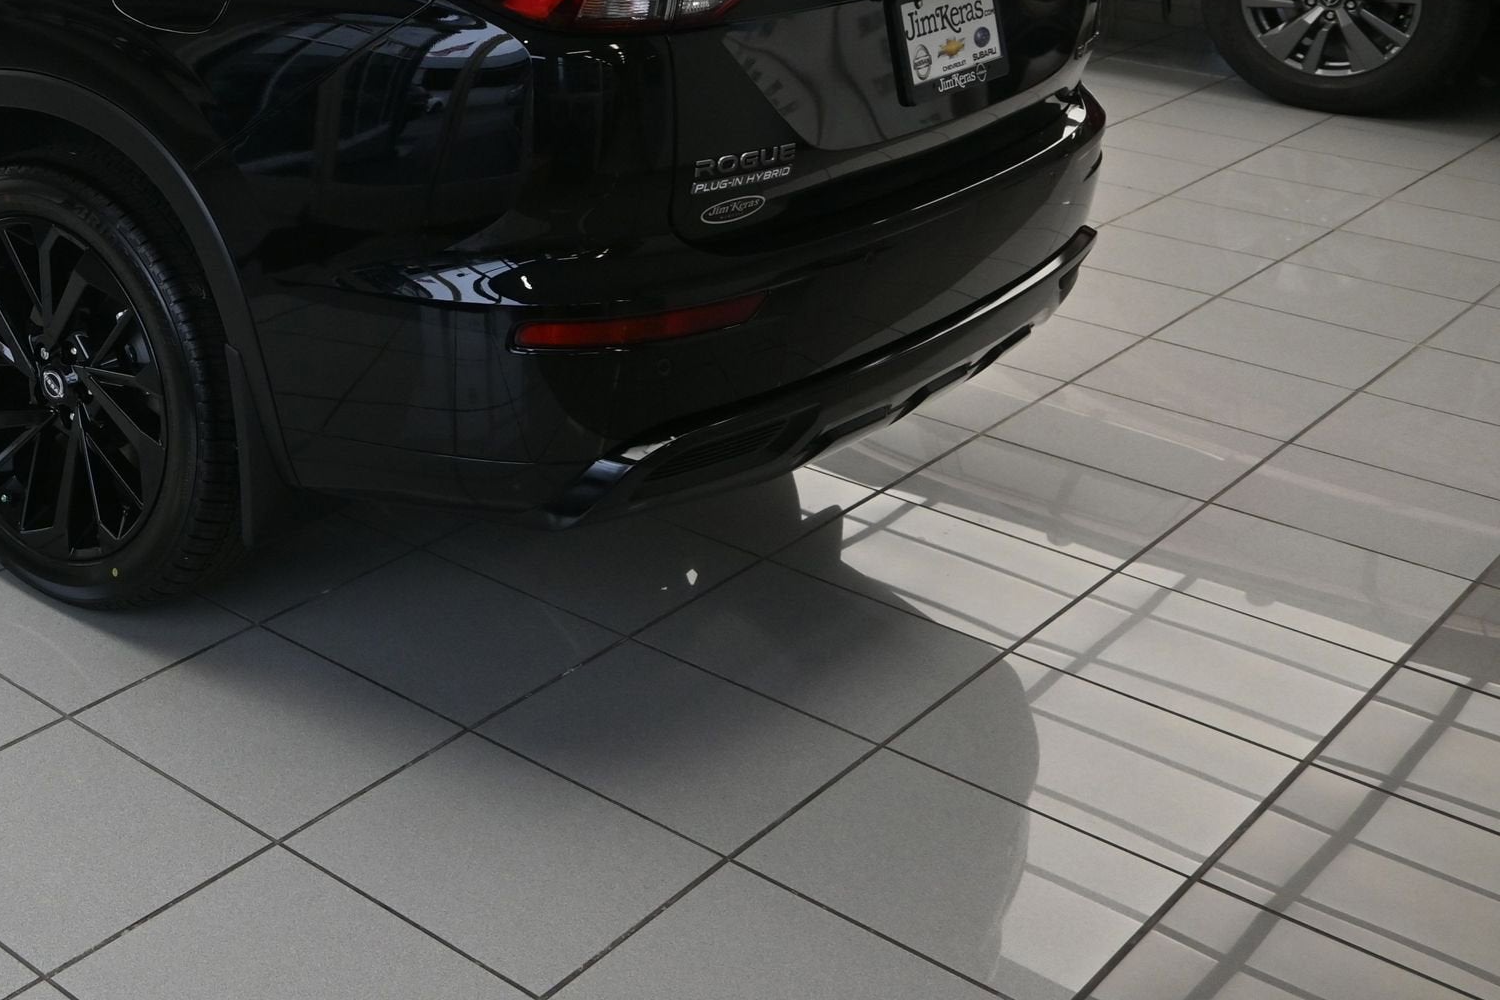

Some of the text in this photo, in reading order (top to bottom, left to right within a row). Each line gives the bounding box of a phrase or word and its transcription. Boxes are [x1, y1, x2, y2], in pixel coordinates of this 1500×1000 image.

[972, 47, 997, 61] SUBARU
[942, 59, 967, 72] CHEVROLET
[694, 142, 796, 178] ROGUE
[745, 166, 791, 184] HYBRID
